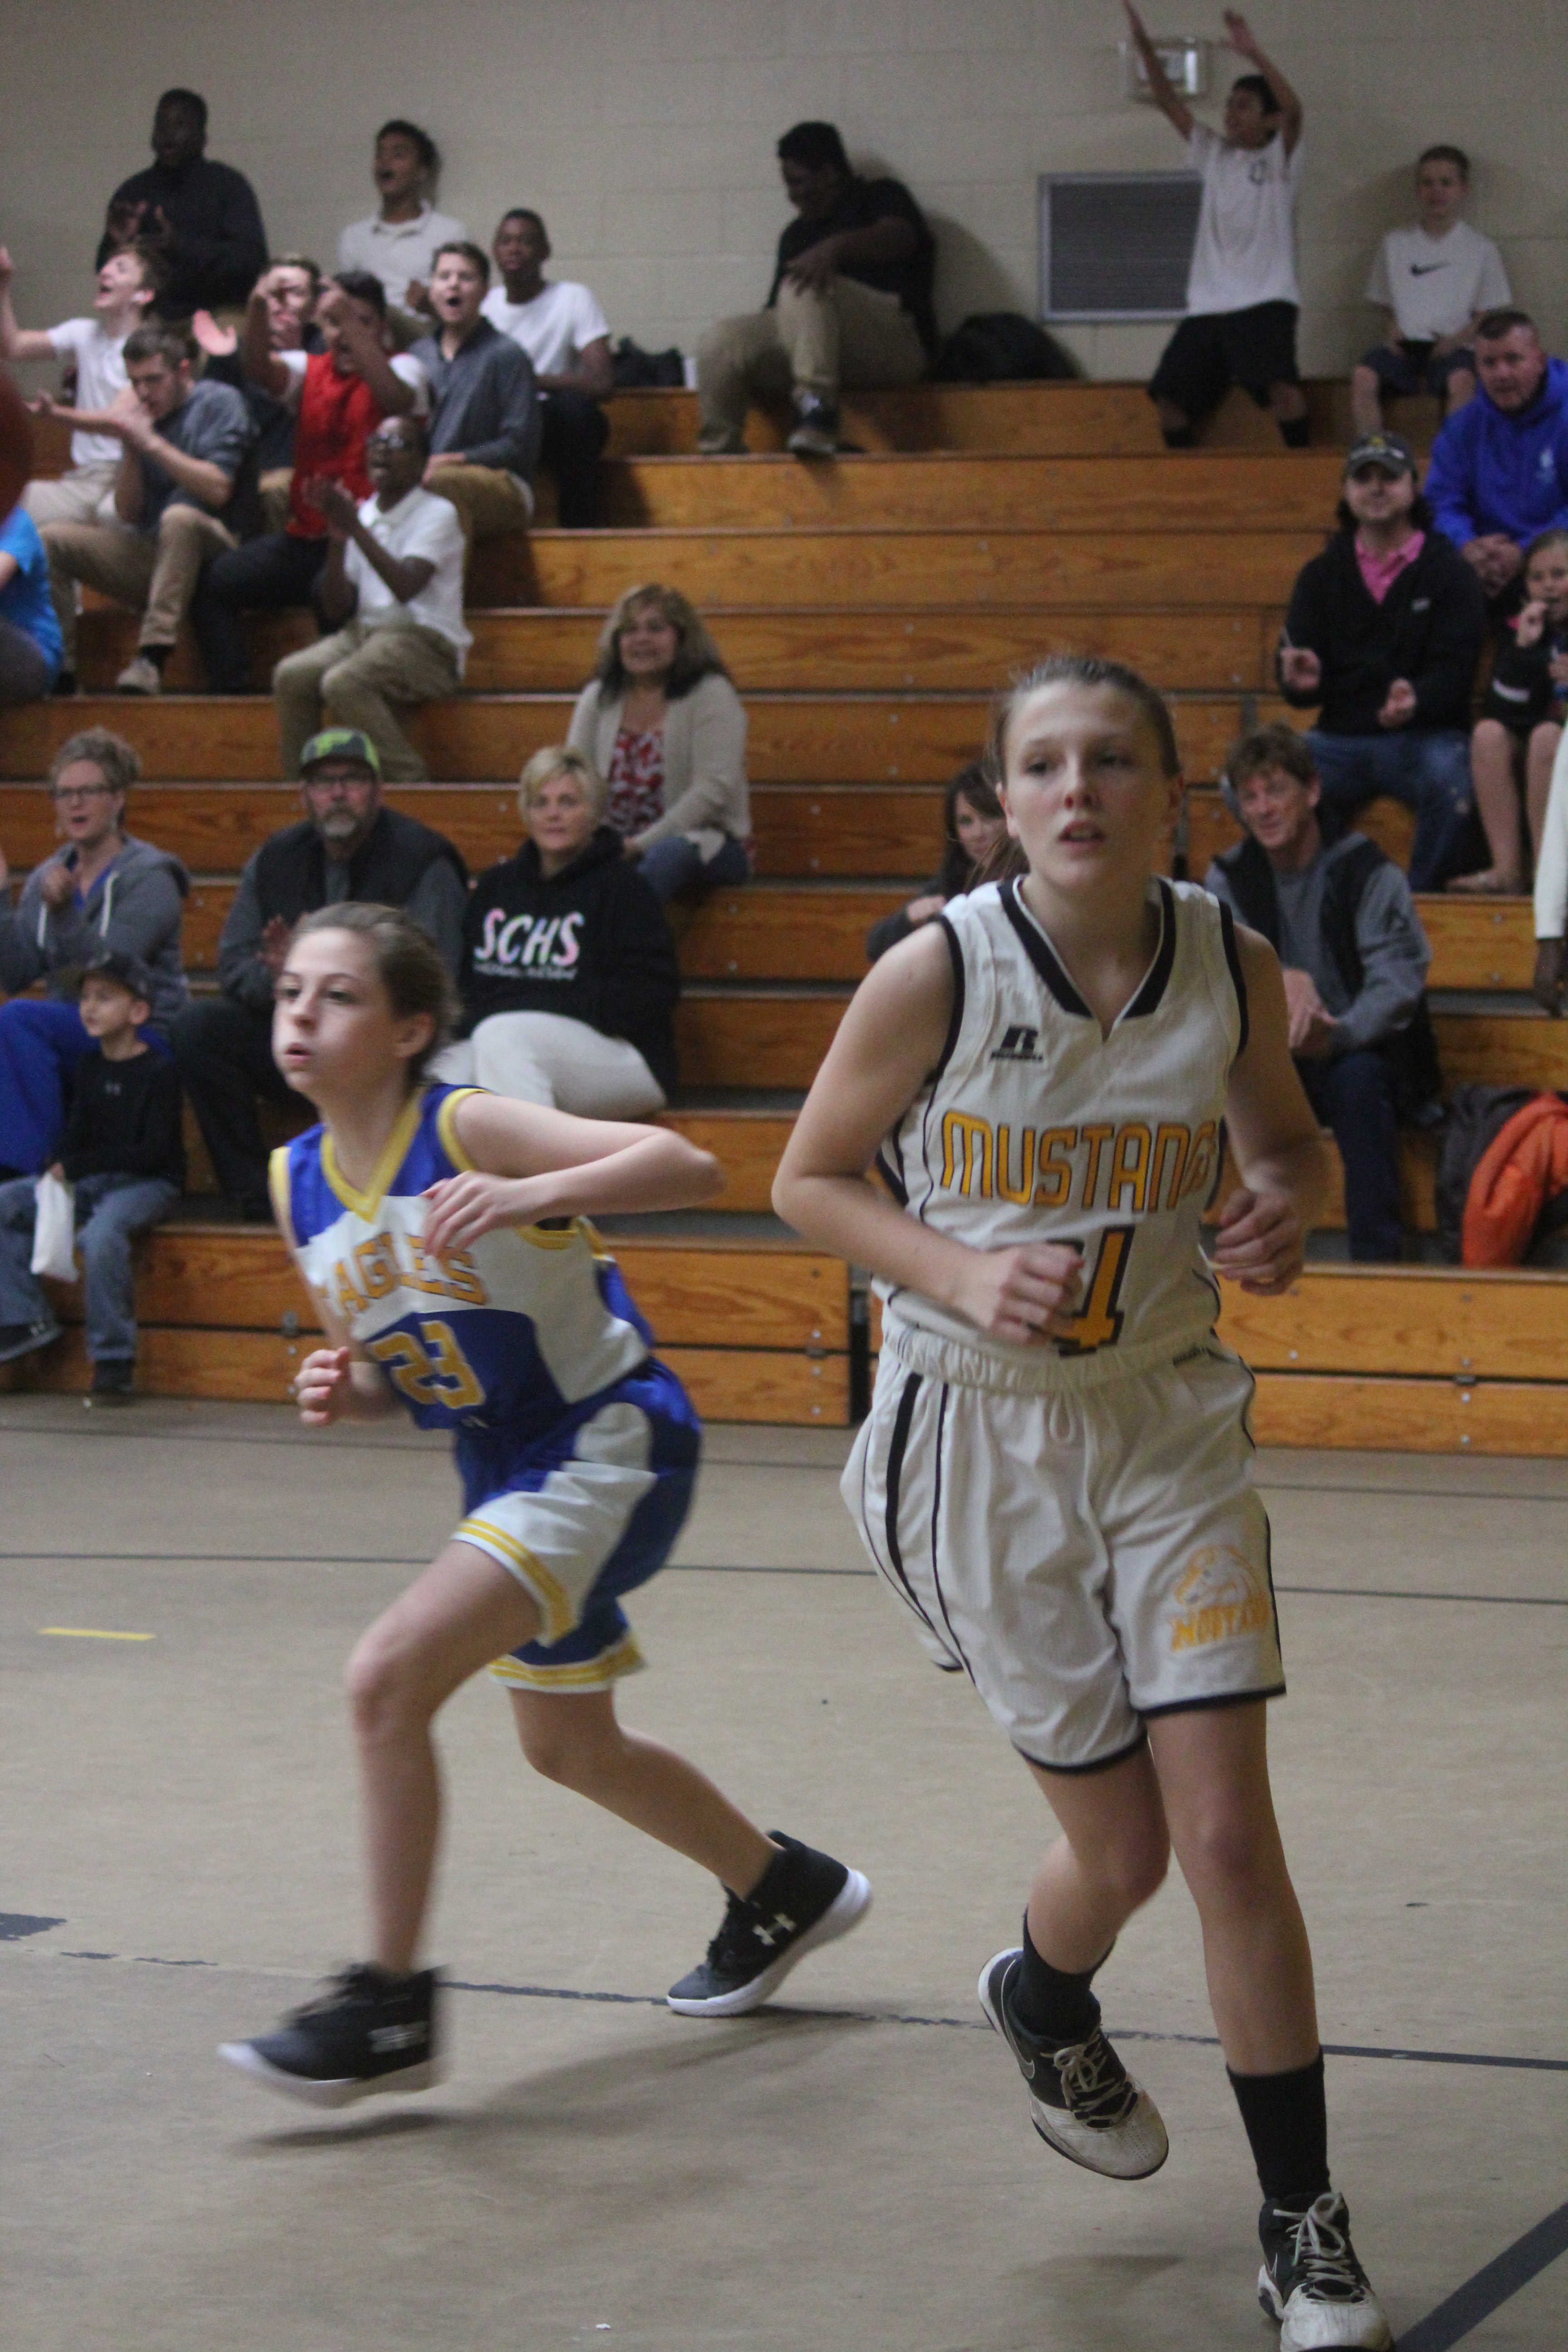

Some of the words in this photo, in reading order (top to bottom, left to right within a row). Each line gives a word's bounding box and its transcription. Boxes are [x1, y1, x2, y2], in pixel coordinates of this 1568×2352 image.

[474, 907, 584, 966] SCHS
[940, 1110, 1216, 1212] MUSTANG
[317, 1231, 488, 1322] AGLES
[369, 1320, 486, 1409] 23
